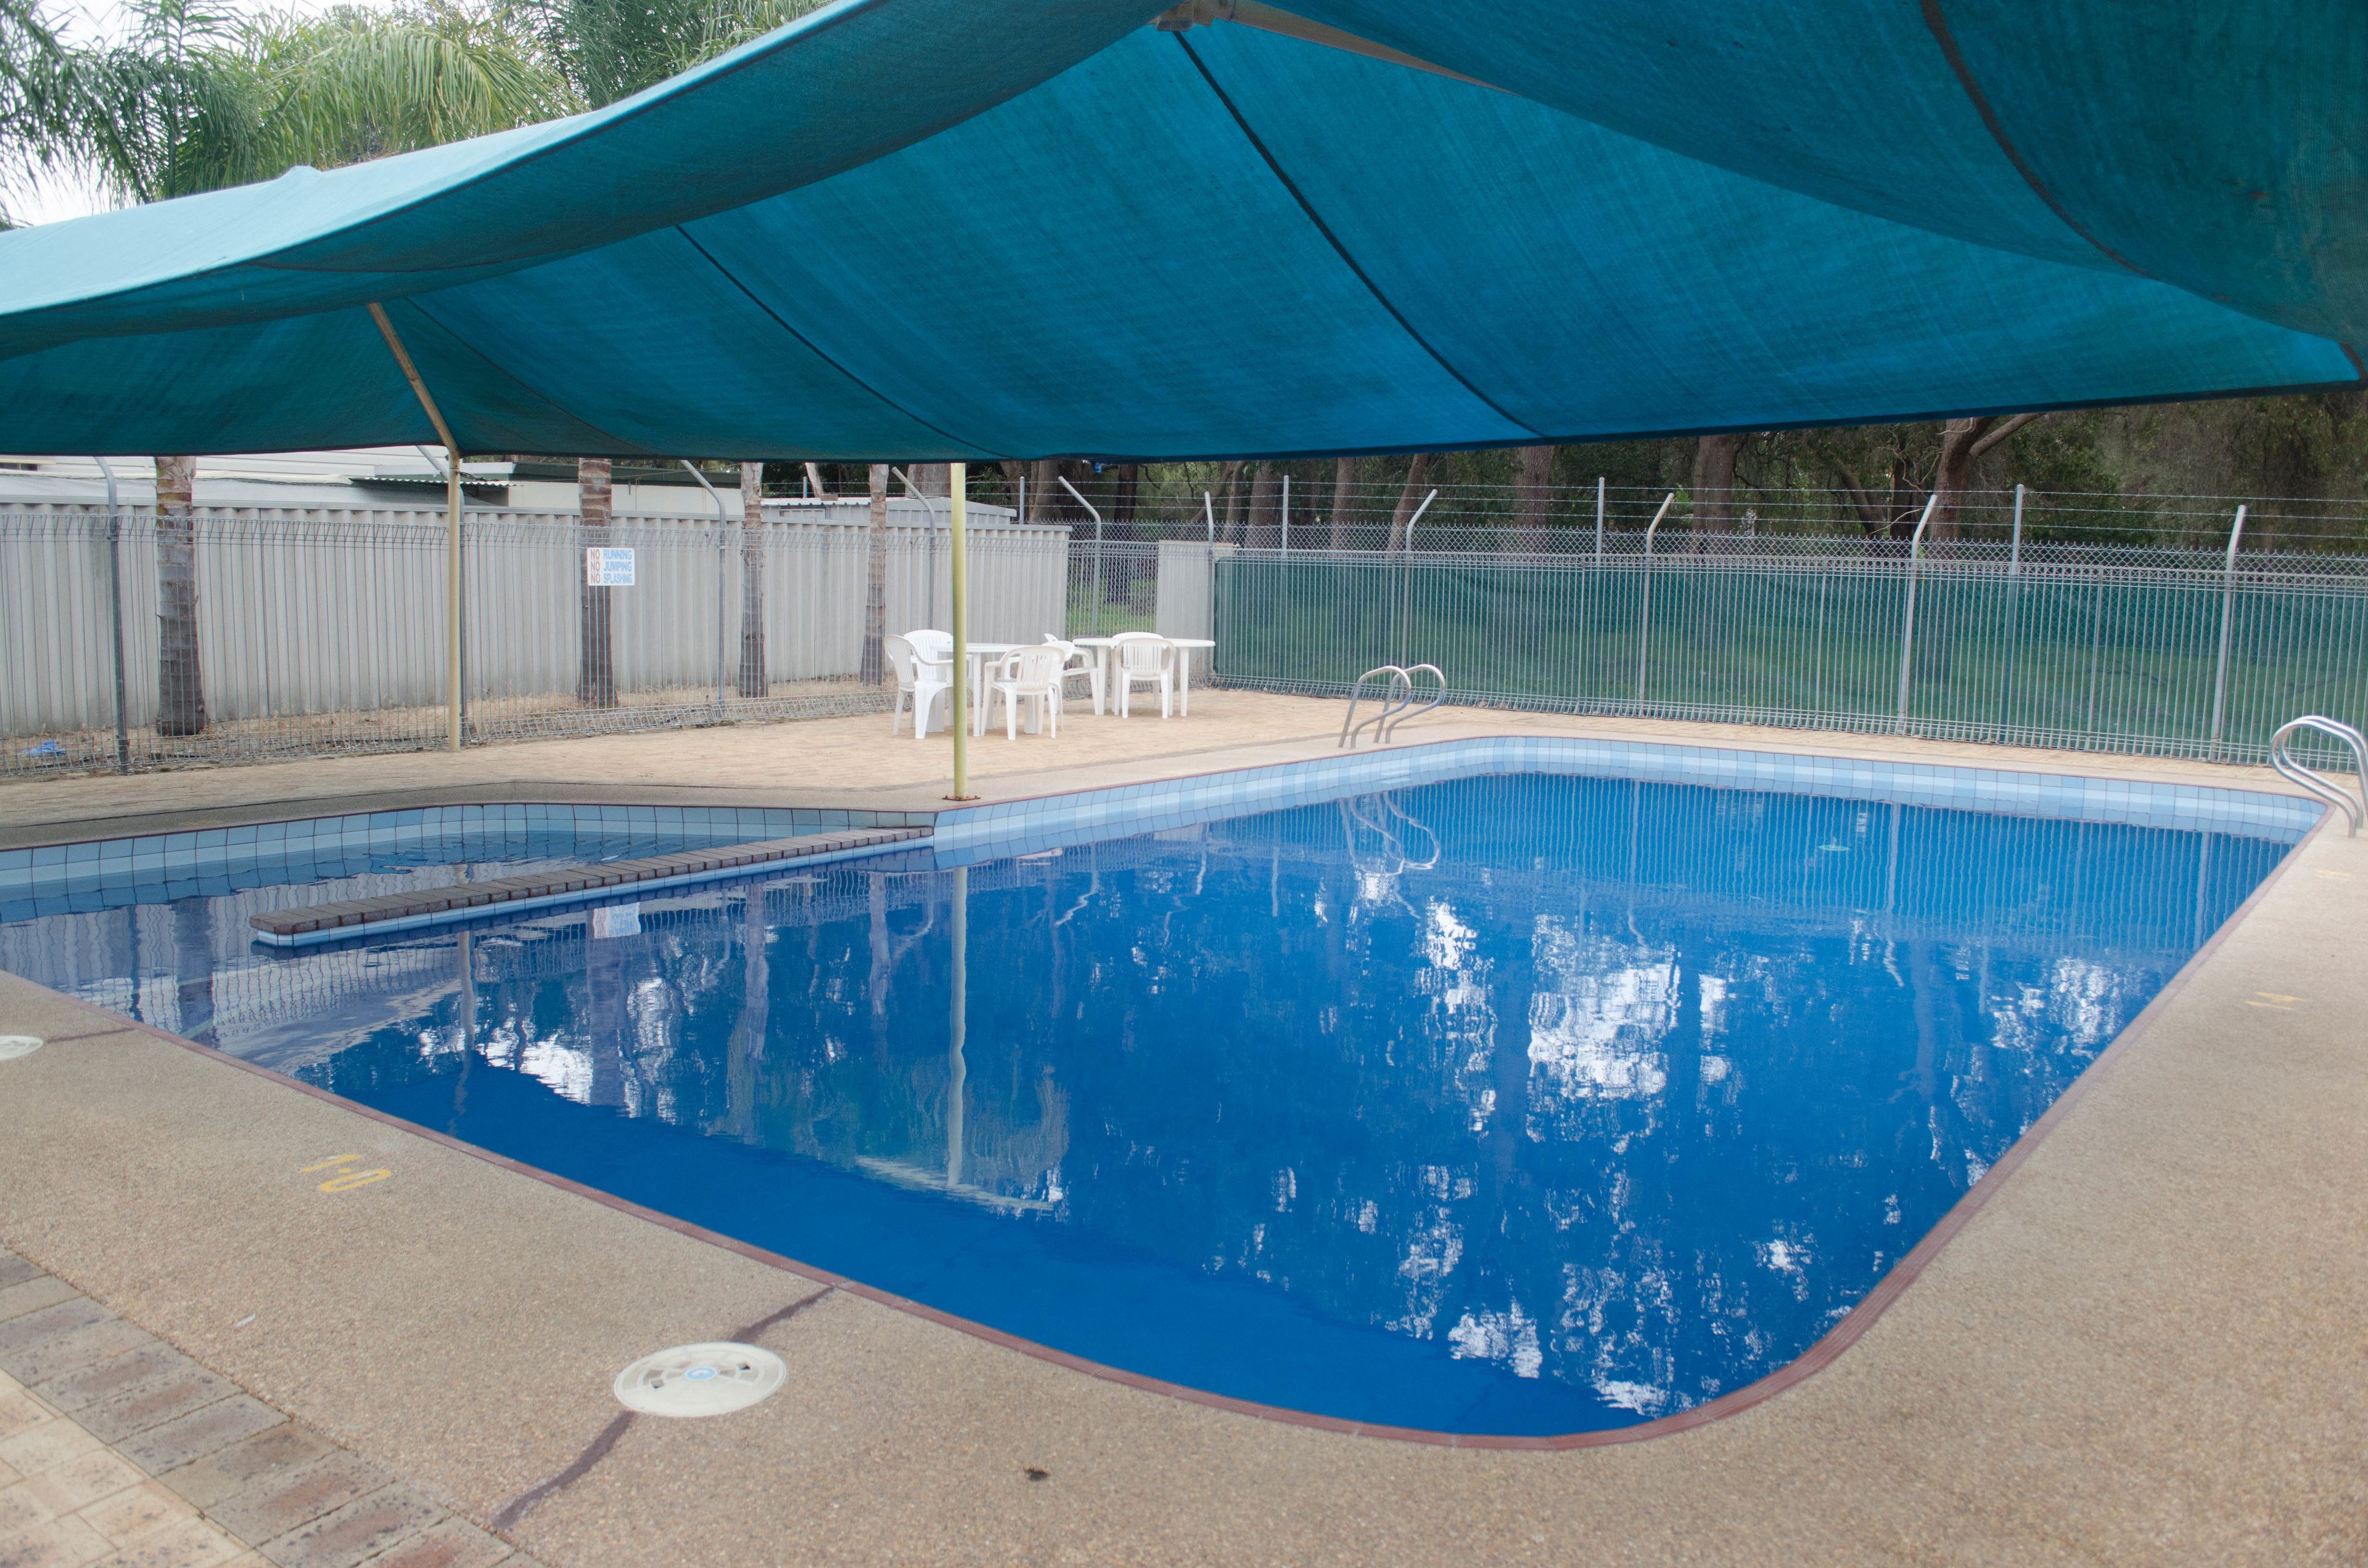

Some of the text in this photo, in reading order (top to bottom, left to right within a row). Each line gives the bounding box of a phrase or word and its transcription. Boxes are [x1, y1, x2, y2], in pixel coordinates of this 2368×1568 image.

[590, 549, 632, 560] NO RUNNING
[590, 561, 632, 572] NO JUMPING
[591, 573, 632, 583] NO SPLASHING
